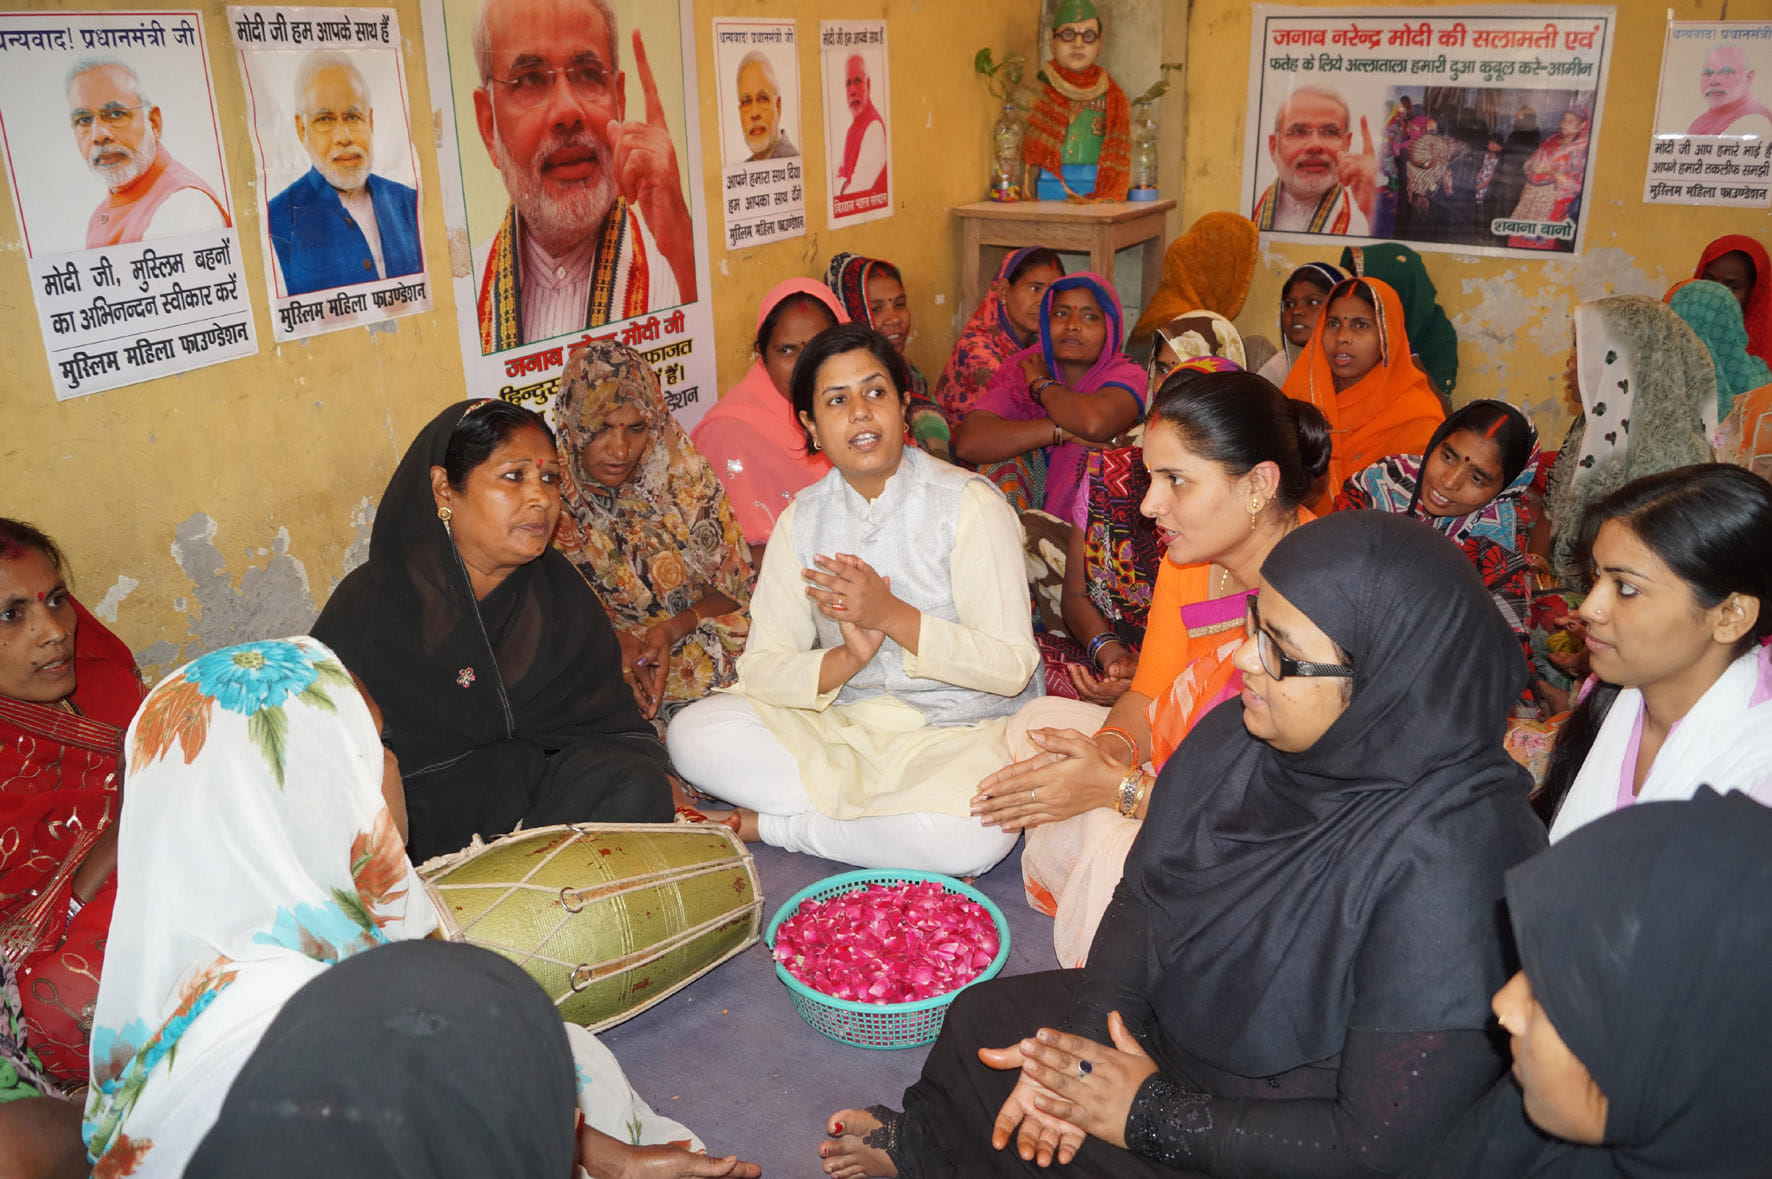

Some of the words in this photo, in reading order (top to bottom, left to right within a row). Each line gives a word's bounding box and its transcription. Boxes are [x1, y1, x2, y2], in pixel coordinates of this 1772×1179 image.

[79, 20, 166, 49] प्रधानमंत्री
[172, 20, 197, 47] जी
[235, 12, 267, 43] मोदी
[268, 12, 289, 42] जी
[290, 21, 314, 44] हम
[316, 15, 352, 42] आपके
[354, 21, 379, 41] साथ
[379, 13, 391, 43] हैं
[784, 27, 794, 44] जी
[1272, 29, 1328, 46] जनाब
[1331, 23, 1384, 50] नरेन्द्र
[1388, 22, 1433, 47] मोदी
[1438, 22, 1467, 47] की
[1472, 23, 1559, 49] सलामती
[1564, 24, 1600, 50] एवं
[1270, 53, 1299, 72] फतेह
[1302, 53, 1315, 71] के
[1318, 53, 1343, 72] लिये
[1345, 58, 1408, 73] अल्लाताला
[1411, 54, 1446, 74] हमारी
[1450, 60, 1476, 81] दुआ
[1655, 139, 1674, 154] मोदी
[1679, 139, 1691, 155] जी
[1695, 144, 1713, 156] आप
[1717, 141, 1740, 157] हमारे
[1743, 141, 1761, 158] भाई
[726, 168, 748, 189] आपने
[749, 168, 770, 188] हमारा
[772, 168, 786, 184] साथ
[787, 162, 800, 180] दिया
[1652, 159, 1677, 173] आपने
[1678, 159, 1703, 175] हमारी
[1704, 160, 1741, 175] तकलीफ
[1742, 161, 1770, 178] समझी
[728, 198, 740, 213] हम
[745, 193, 770, 210] आपका
[773, 191, 788, 205] साथ
[1650, 182, 1683, 199] मुस्लिम
[1686, 184, 1717, 198] महिला
[1720, 185, 1768, 200] फाउण्डेशन
[729, 223, 753, 246] मुस्लिम
[755, 219, 776, 236] महिला
[42, 261, 82, 296] मोदी
[90, 255, 121, 288] जी,
[130, 248, 186, 293] मुस्लिम
[193, 237, 232, 271] बहनों
[50, 311, 77, 335] का
[79, 295, 159, 331] अभिनन्दन
[160, 281, 213, 314] स्वीकार
[214, 272, 239, 300] करें
[278, 300, 324, 333] मुस्लिम
[327, 292, 368, 316] महिला
[371, 281, 426, 309] फाउण्डेशन
[58, 351, 121, 389] मुस्लिम
[123, 337, 176, 367] महिला
[178, 321, 249, 354] फाउण्डेशन
[505, 345, 563, 379] जनाब
[621, 316, 660, 347] मोदी
[664, 309, 686, 334] जी
